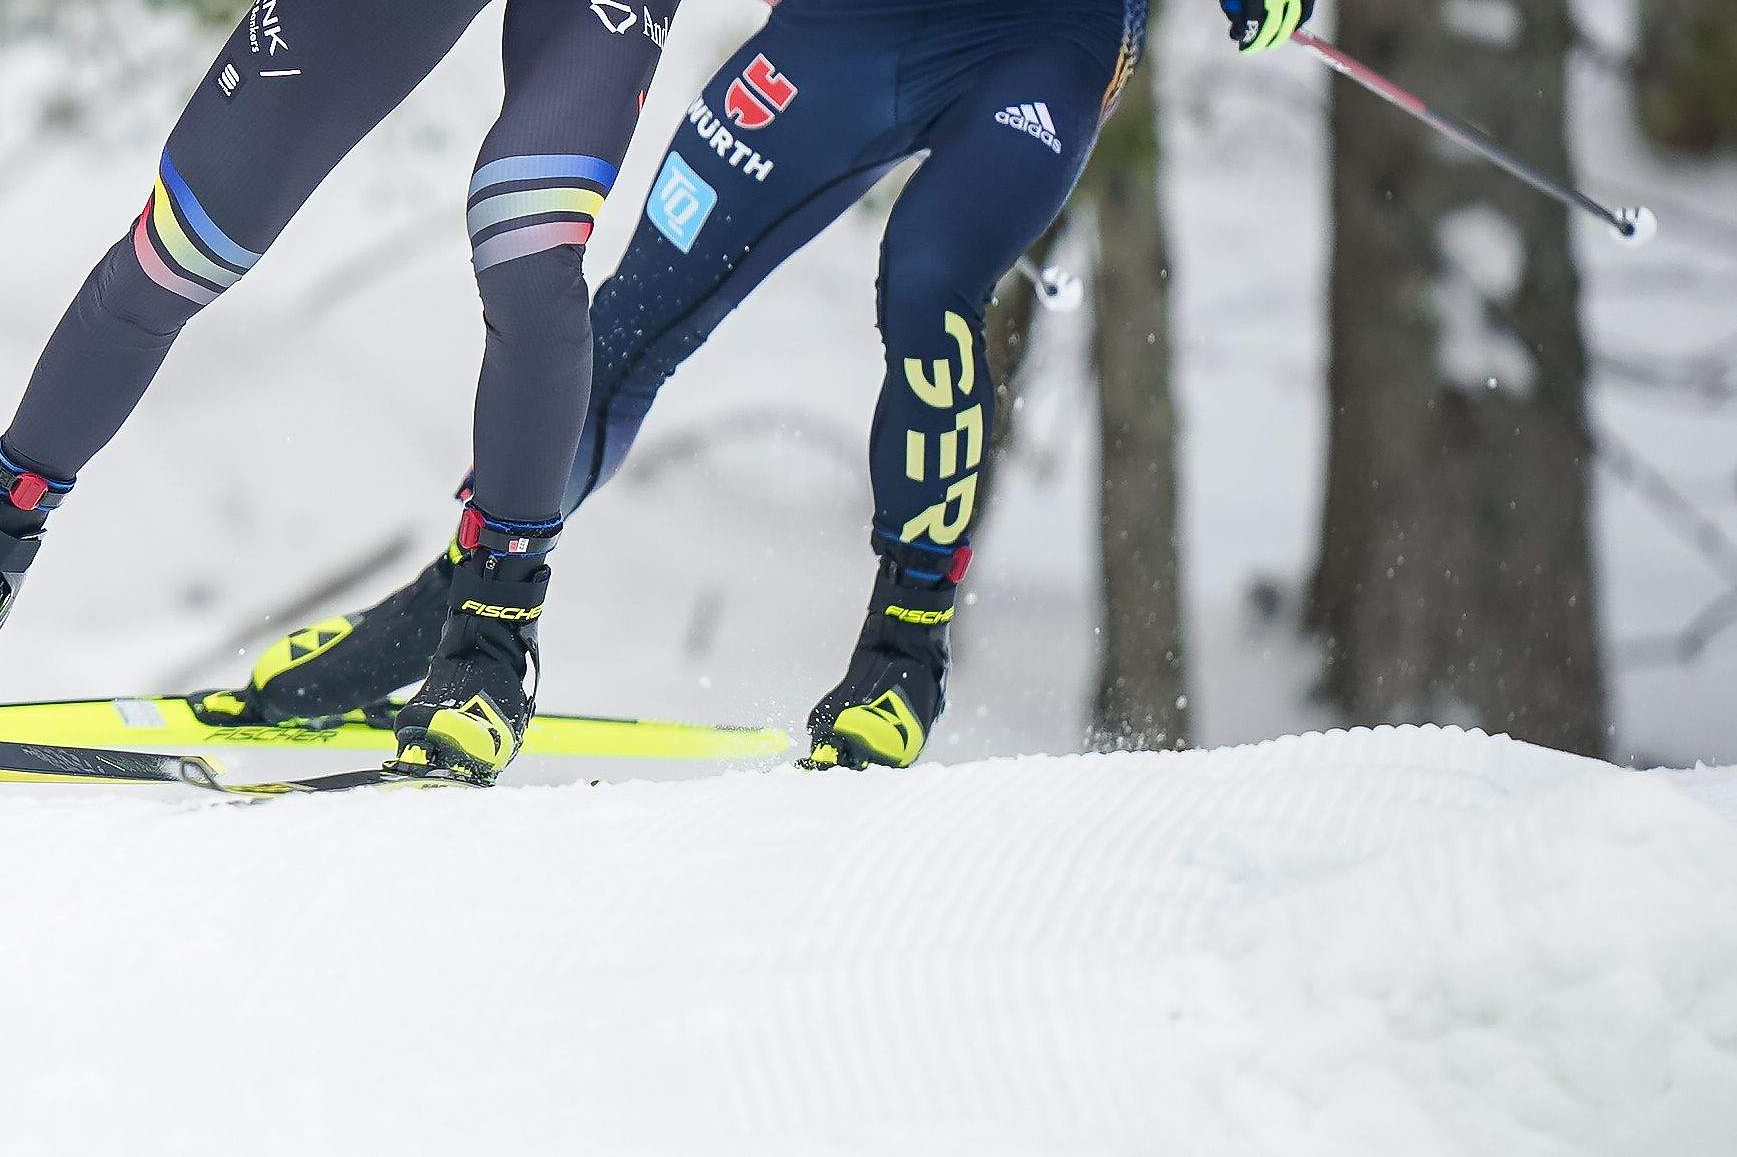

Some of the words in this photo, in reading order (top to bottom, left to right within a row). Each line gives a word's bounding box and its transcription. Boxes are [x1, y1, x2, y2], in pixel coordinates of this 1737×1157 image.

[994, 110, 1062, 154] adidas
[900, 311, 984, 544] GER
[203, 727, 339, 743] FISCHER
